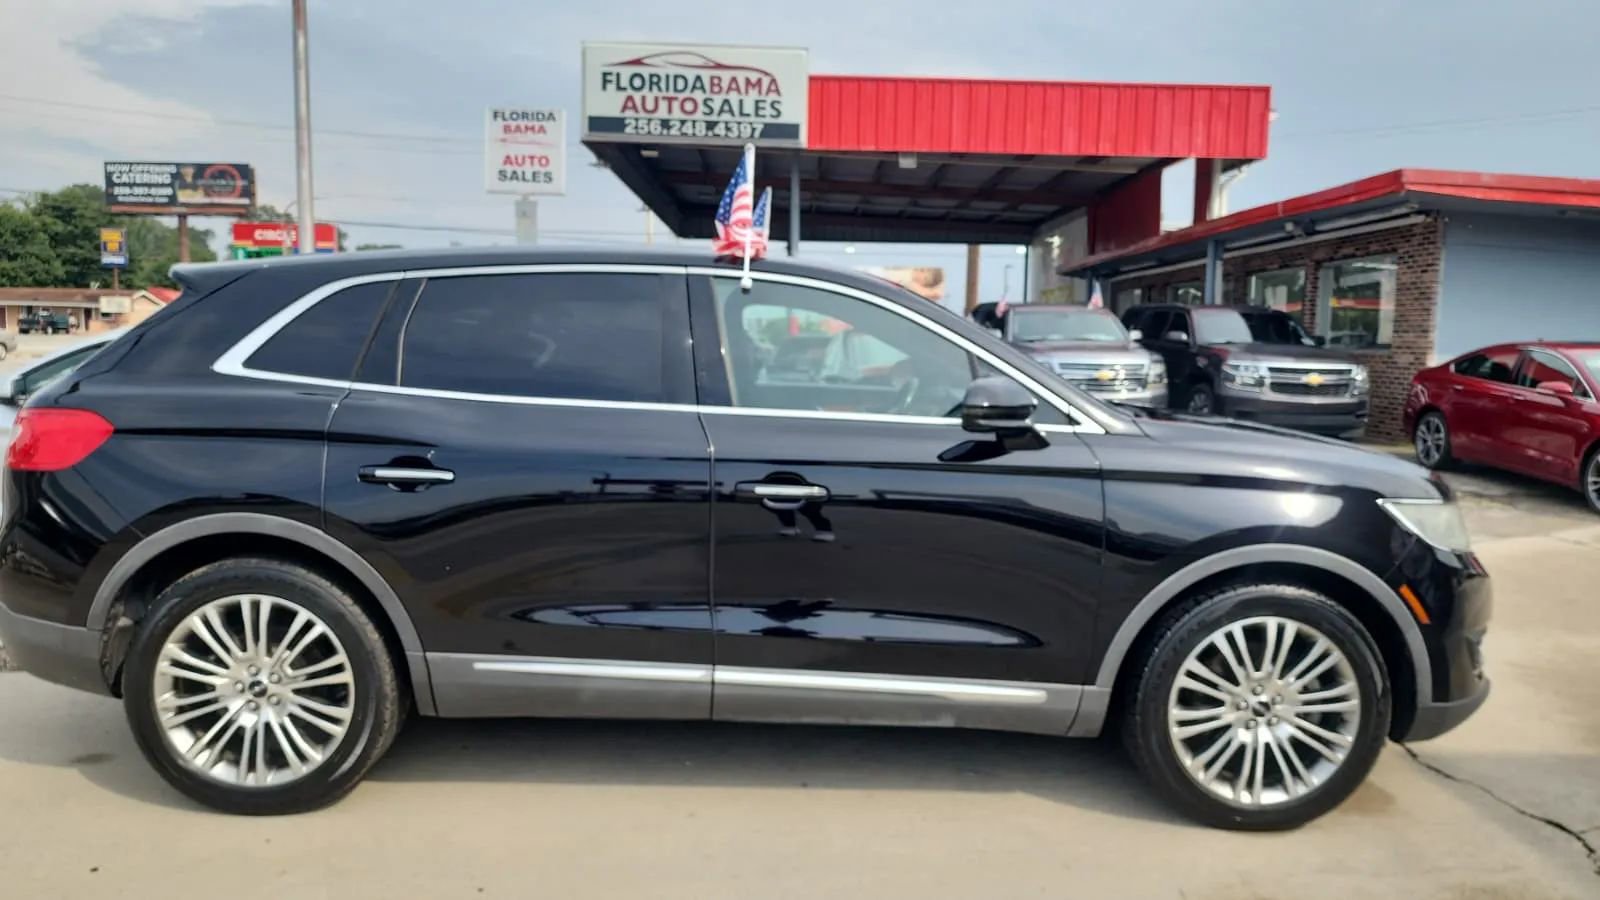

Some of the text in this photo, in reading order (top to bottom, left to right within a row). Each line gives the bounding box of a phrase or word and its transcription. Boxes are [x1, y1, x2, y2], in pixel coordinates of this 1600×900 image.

[492, 110, 557, 122] FLORIDA
[503, 124, 547, 135] BAMA
[623, 117, 765, 139] 256.248.4397
[503, 154, 550, 168] AUTO
[106, 163, 177, 174] NOW OFFERING
[112, 172, 172, 185] CATERING
[497, 169, 554, 184] SALES
[253, 228, 297, 242] CIRCE
